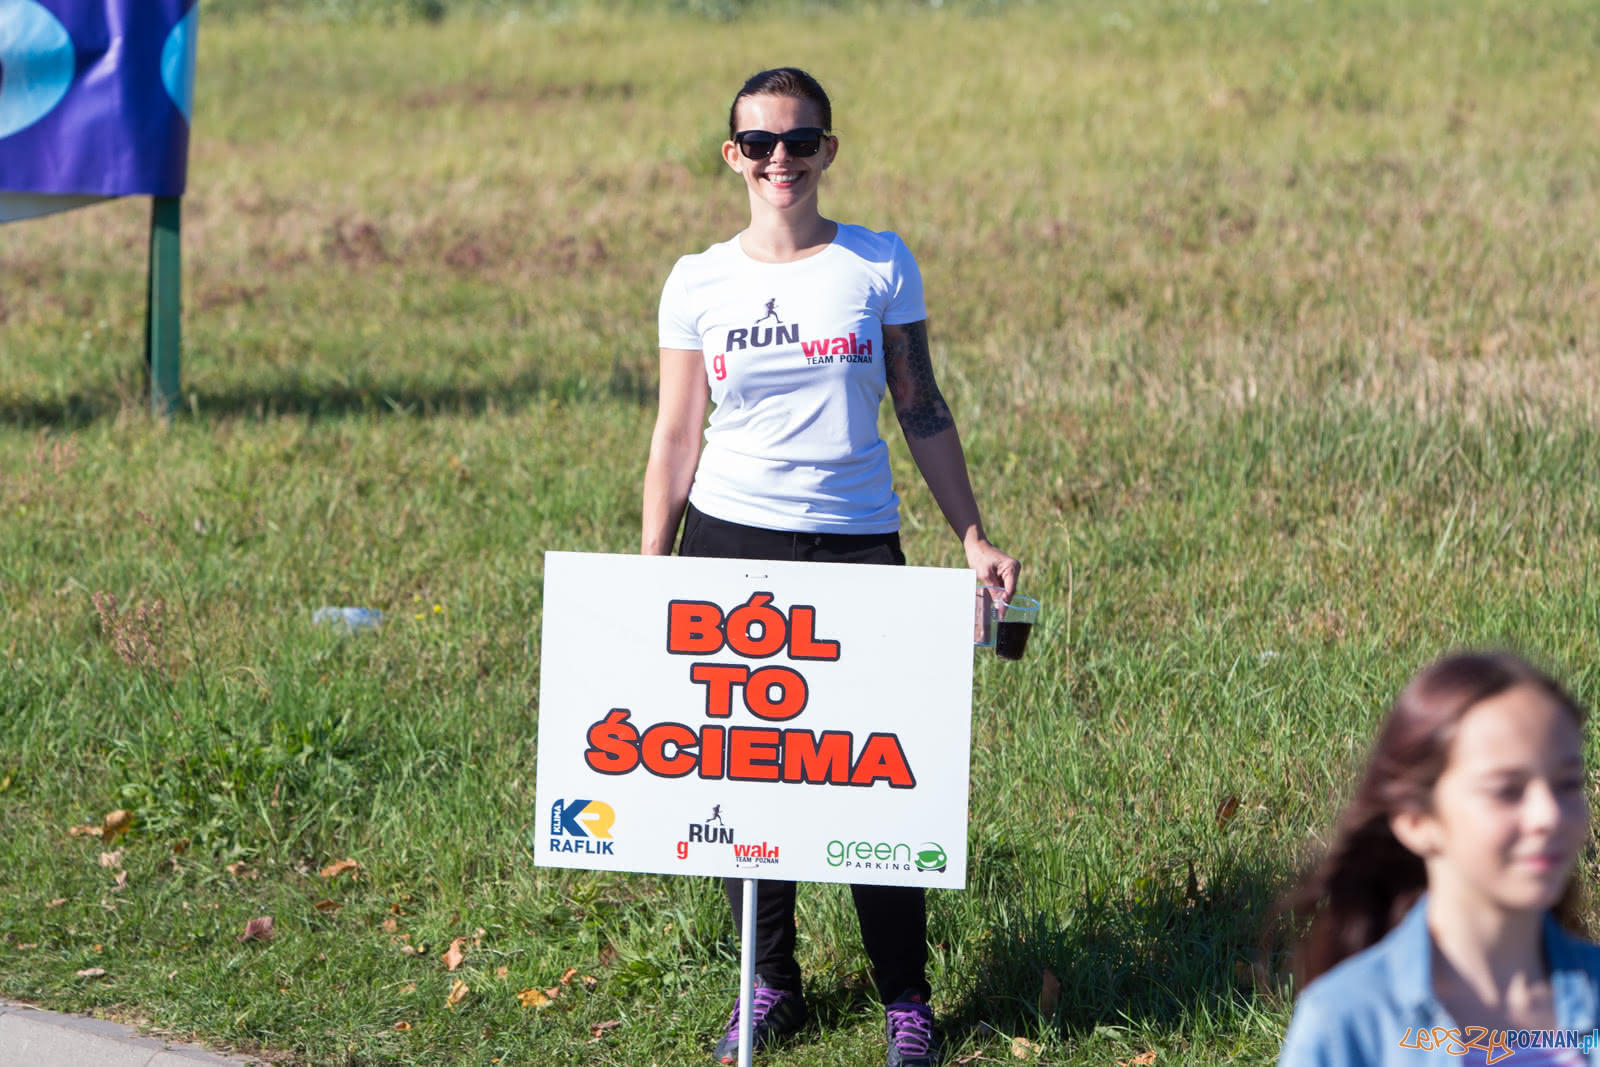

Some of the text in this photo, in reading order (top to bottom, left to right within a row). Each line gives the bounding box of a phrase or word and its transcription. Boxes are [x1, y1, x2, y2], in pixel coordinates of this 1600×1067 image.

[807, 354, 834, 365] TEAM
[667, 592, 840, 661] BÓL
[690, 662, 809, 722] TO
[584, 708, 916, 789] ŚCIEMA
[553, 804, 561, 833] KLIMA
[550, 838, 615, 856] RAFLIK
[827, 840, 911, 867] green
[846, 861, 911, 871] PARKING
